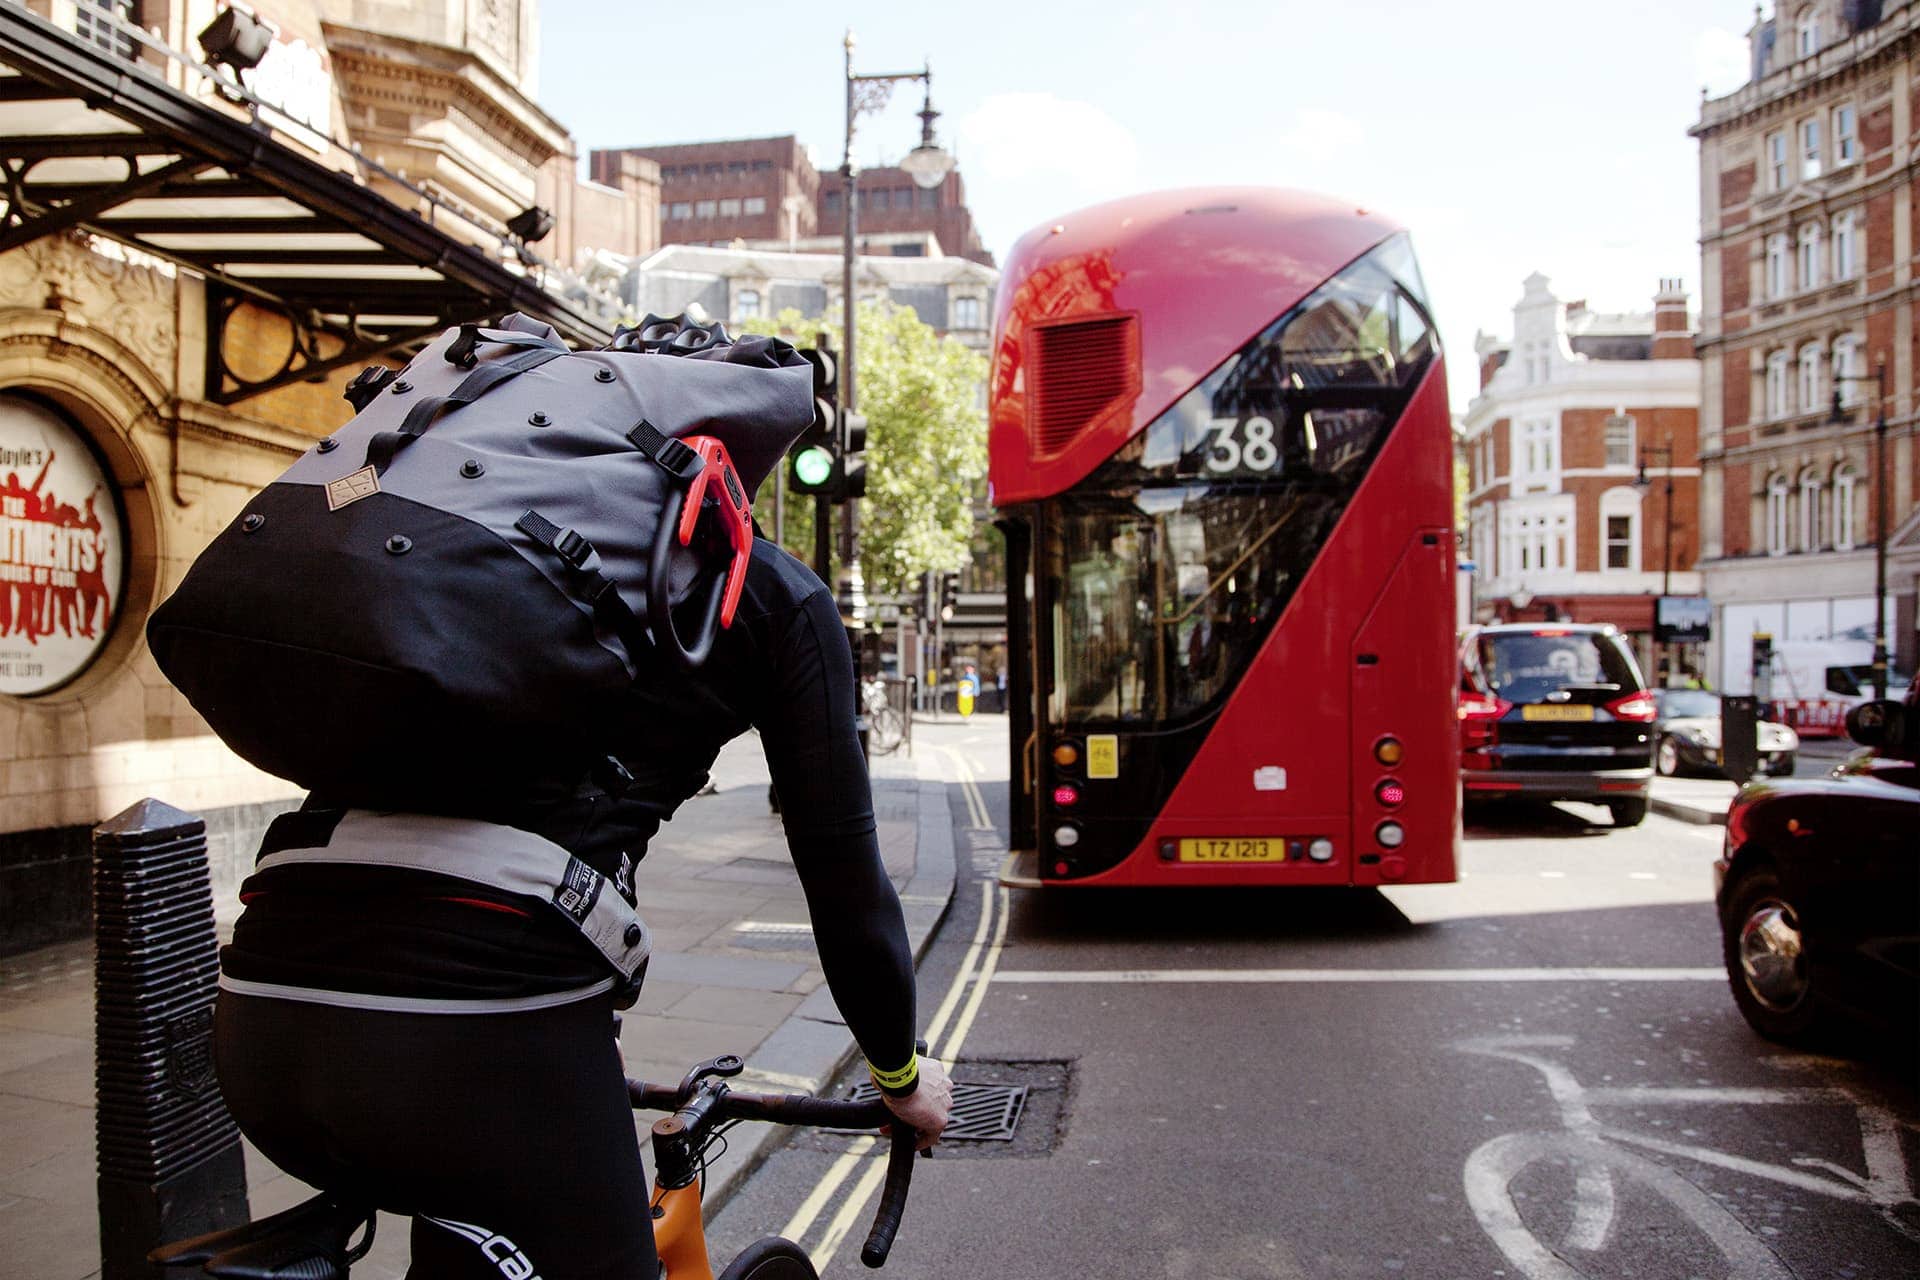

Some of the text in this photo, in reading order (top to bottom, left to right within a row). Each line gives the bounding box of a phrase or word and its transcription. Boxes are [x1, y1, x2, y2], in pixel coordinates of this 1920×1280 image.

[1206, 416, 1278, 472] 38
[1195, 841, 1269, 858] LTZ 1213
